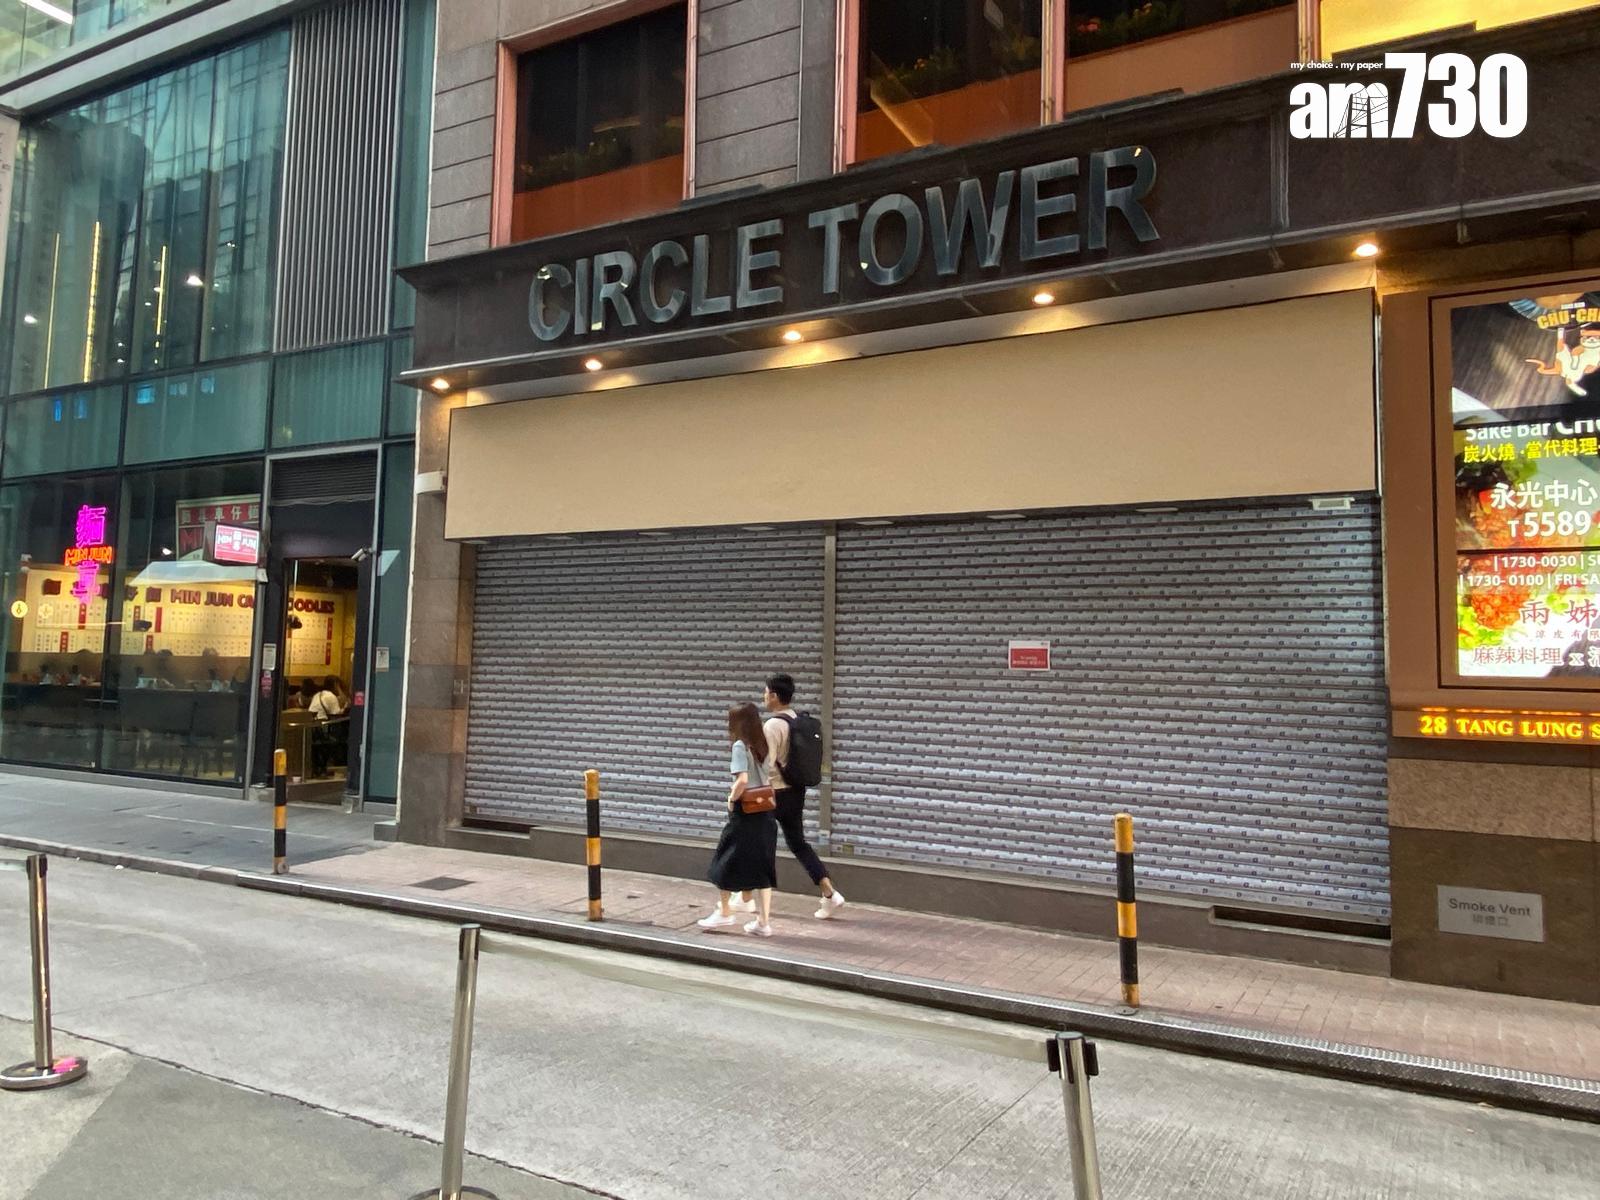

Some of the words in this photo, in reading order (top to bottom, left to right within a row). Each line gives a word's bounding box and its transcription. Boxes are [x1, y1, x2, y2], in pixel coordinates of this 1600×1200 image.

[528, 218, 785, 341] CIRCLE
[808, 145, 1161, 294] TOWER
[1490, 479, 1598, 509] 永光中心
[1524, 510, 1591, 537] 5589
[65, 549, 88, 566] MIN
[88, 546, 112, 564] JUN
[1555, 574, 1578, 586] FRI
[170, 589, 201, 605] MIN
[204, 591, 233, 607] JUN
[1474, 646, 1562, 665] 麻辣料理
[1420, 715, 1447, 734] 28
[1456, 718, 1513, 736] TANG
[1521, 721, 1584, 739] LUNG
[1448, 898, 1496, 913] Smoke
[1499, 903, 1531, 916] Vent
